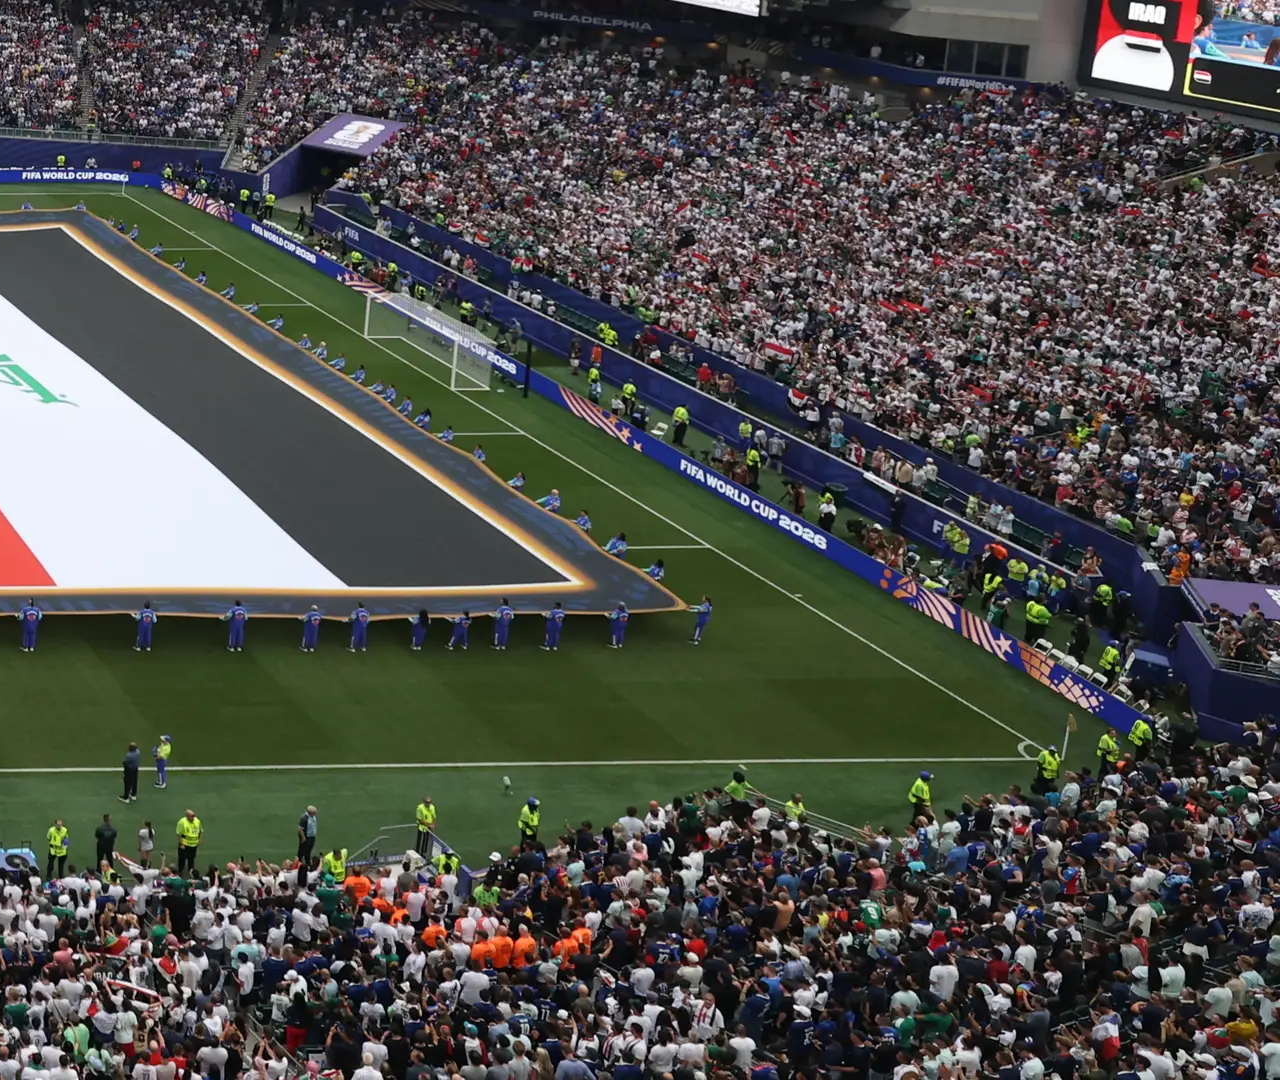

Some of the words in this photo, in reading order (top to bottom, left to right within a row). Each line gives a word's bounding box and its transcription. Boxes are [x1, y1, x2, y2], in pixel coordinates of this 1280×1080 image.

[533, 10, 653, 31] PHILADELPHIA
[1128, 2, 1166, 24] IRAQ
[22, 172, 40, 180] FIFA
[42, 172, 75, 180] WORLD
[76, 172, 94, 181] CUP
[95, 173, 128, 182] 2026
[252, 223, 264, 238] FIFA
[264, 229, 283, 246] WORLD
[284, 240, 296, 252] CUP
[296, 247, 316, 264] 2026
[344, 226, 359, 241] FIFA
[471, 341, 487, 357] CUP
[487, 352, 517, 375] 2026
[680, 459, 705, 483] FIFA
[706, 473, 751, 507] WORLD
[751, 499, 778, 521] CUP
[778, 514, 828, 550] 2026
[872, 907, 878, 919] 9
